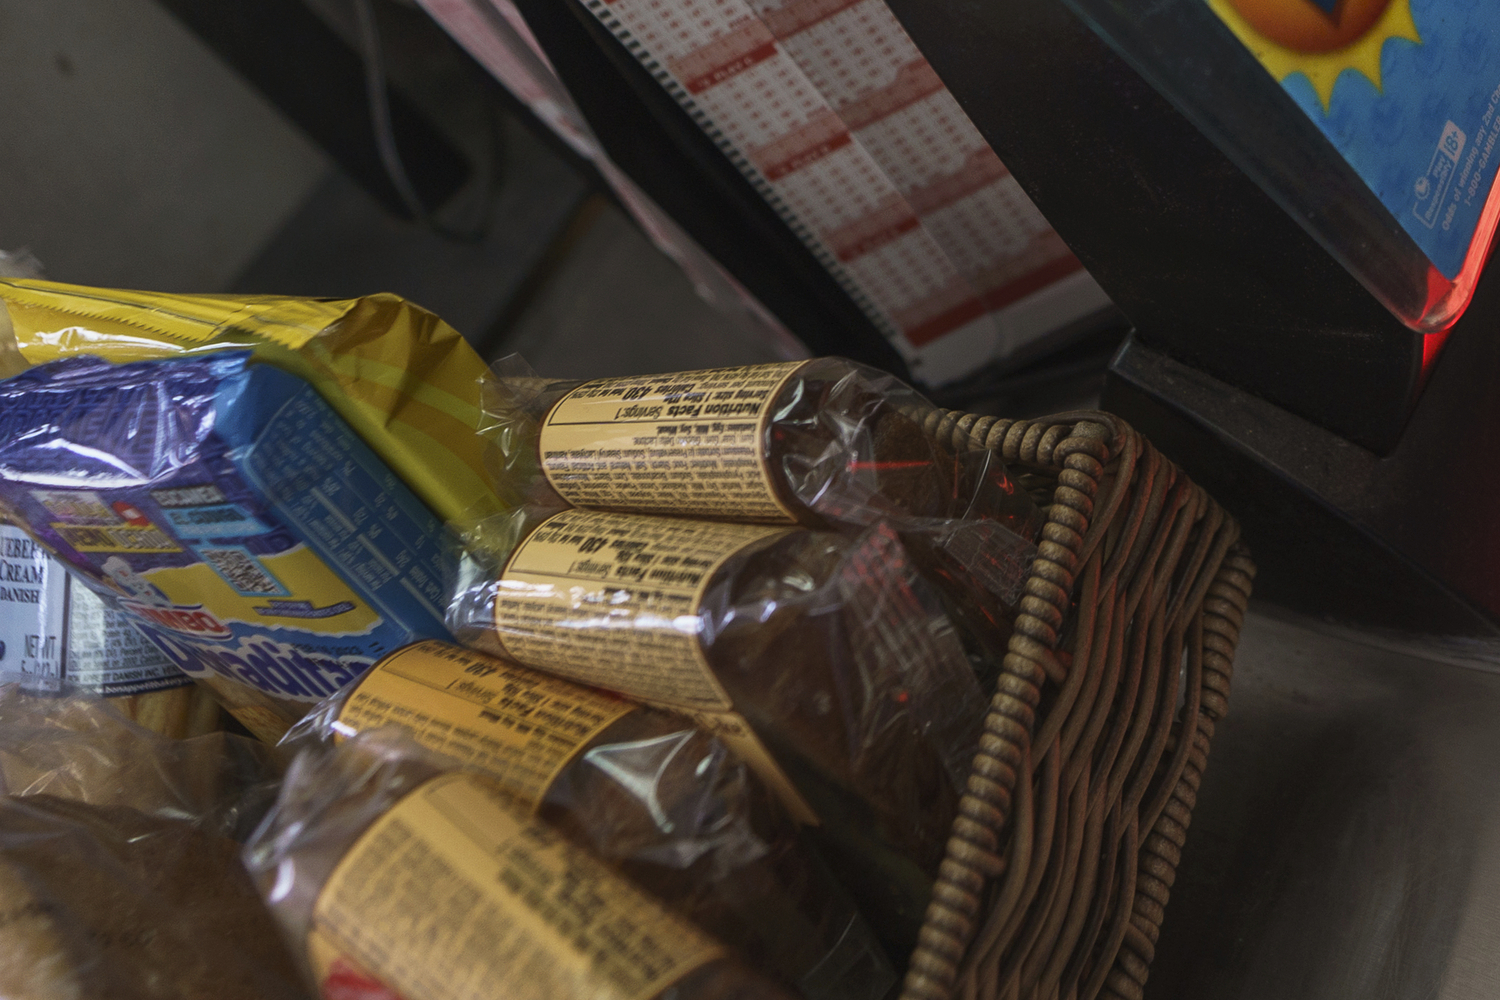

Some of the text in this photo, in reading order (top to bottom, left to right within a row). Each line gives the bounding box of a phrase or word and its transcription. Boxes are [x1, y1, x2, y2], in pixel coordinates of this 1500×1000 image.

[1442, 130, 1459, 156] 18+
[1441, 202, 1457, 230] Odds
[1452, 186, 1462, 201] of
[1457, 146, 1479, 187] winning
[1474, 124, 1487, 146] any
[1481, 102, 1495, 125] 2nd
[621, 385, 652, 400] 430
[666, 405, 701, 416] Facts
[704, 402, 760, 415] Nutrition
[577, 536, 607, 554] 430
[0, 560, 43, 583] CREAM
[0, 587, 39, 603] DANISH
[463, 662, 497, 678] 430
